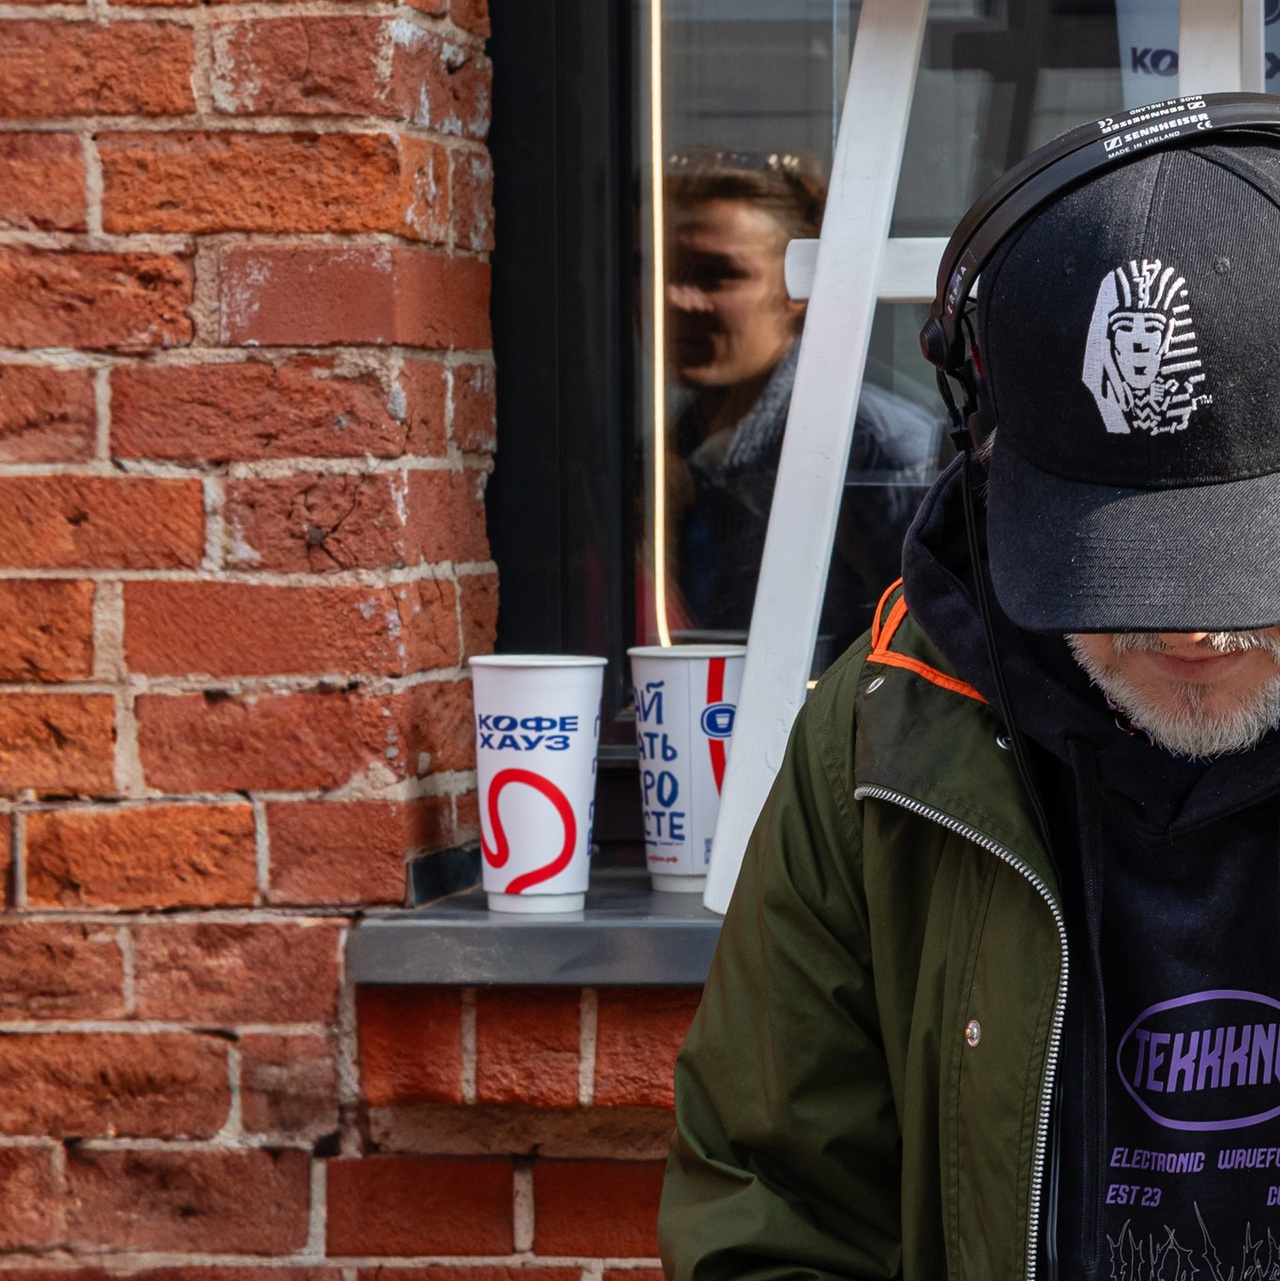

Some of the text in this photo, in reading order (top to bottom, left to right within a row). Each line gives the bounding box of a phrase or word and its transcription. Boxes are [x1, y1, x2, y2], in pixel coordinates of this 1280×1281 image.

[1101, 105, 1185, 134] SENNHEISER
[1124, 112, 1210, 143] SENNHEISER
[1107, 130, 1181, 159] MADE IN IRELAND
[478, 714, 579, 732] КОФЕ
[479, 733, 571, 751] ХАУЗ
[1110, 1147, 1205, 1173] ELECTRONIC
[1105, 1185, 1161, 1207] EST 23
